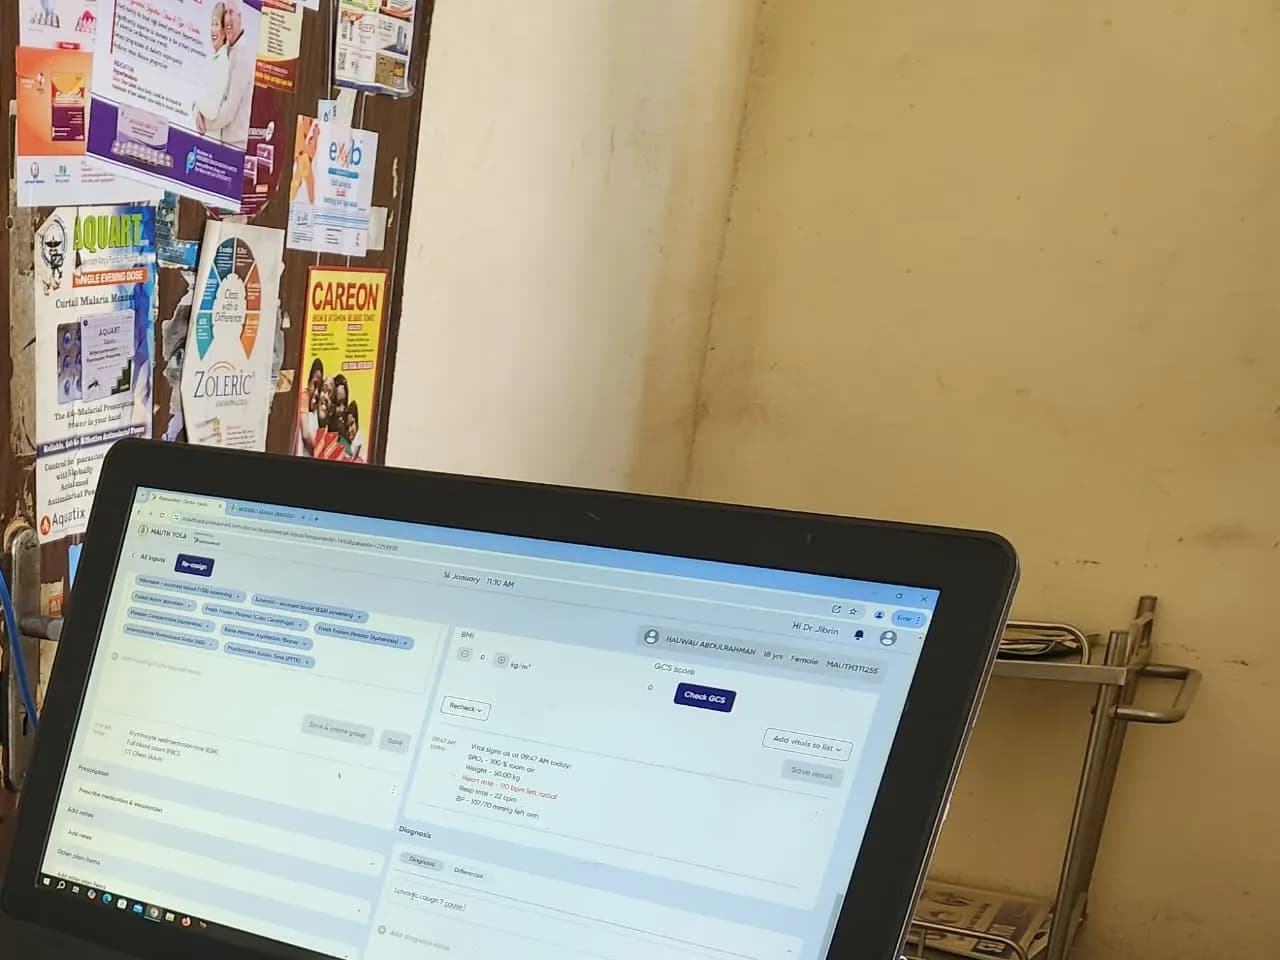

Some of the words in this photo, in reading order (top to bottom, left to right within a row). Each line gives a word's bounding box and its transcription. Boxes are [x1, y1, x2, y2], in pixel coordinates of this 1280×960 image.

[73, 214, 143, 253] AQUART
[127, 270, 143, 280] DOSE
[81, 295, 109, 306] Malaria
[312, 282, 379, 310] CAREON
[452, 573, 480, 585] January
[503, 580, 515, 588] AM
[792, 621, 801, 630] Hi
[699, 640, 756, 656] ABDULRAHMAN
[772, 652, 784, 661] yrs
[790, 655, 819, 666] Female
[654, 662, 672, 672] GCS
[674, 666, 695, 676] score
[684, 691, 707, 702] Check
[709, 694, 726, 704] GCS
[386, 737, 403, 746] Save
[773, 735, 790, 744] Add
[791, 738, 811, 748] vitals
[822, 743, 834, 752] list
[471, 743, 485, 752] Vital
[486, 747, 502, 756] signs
[465, 764, 487, 775] Weight
[791, 766, 811, 777] Save
[811, 769, 833, 780] result
[476, 788, 489, 797] rate
[538, 788, 558, 800] radial
[67, 806, 79, 814] Add
[399, 825, 432, 839] Diagnosis
[56, 848, 72, 858] Other
[409, 856, 435, 867] Diagnosis
